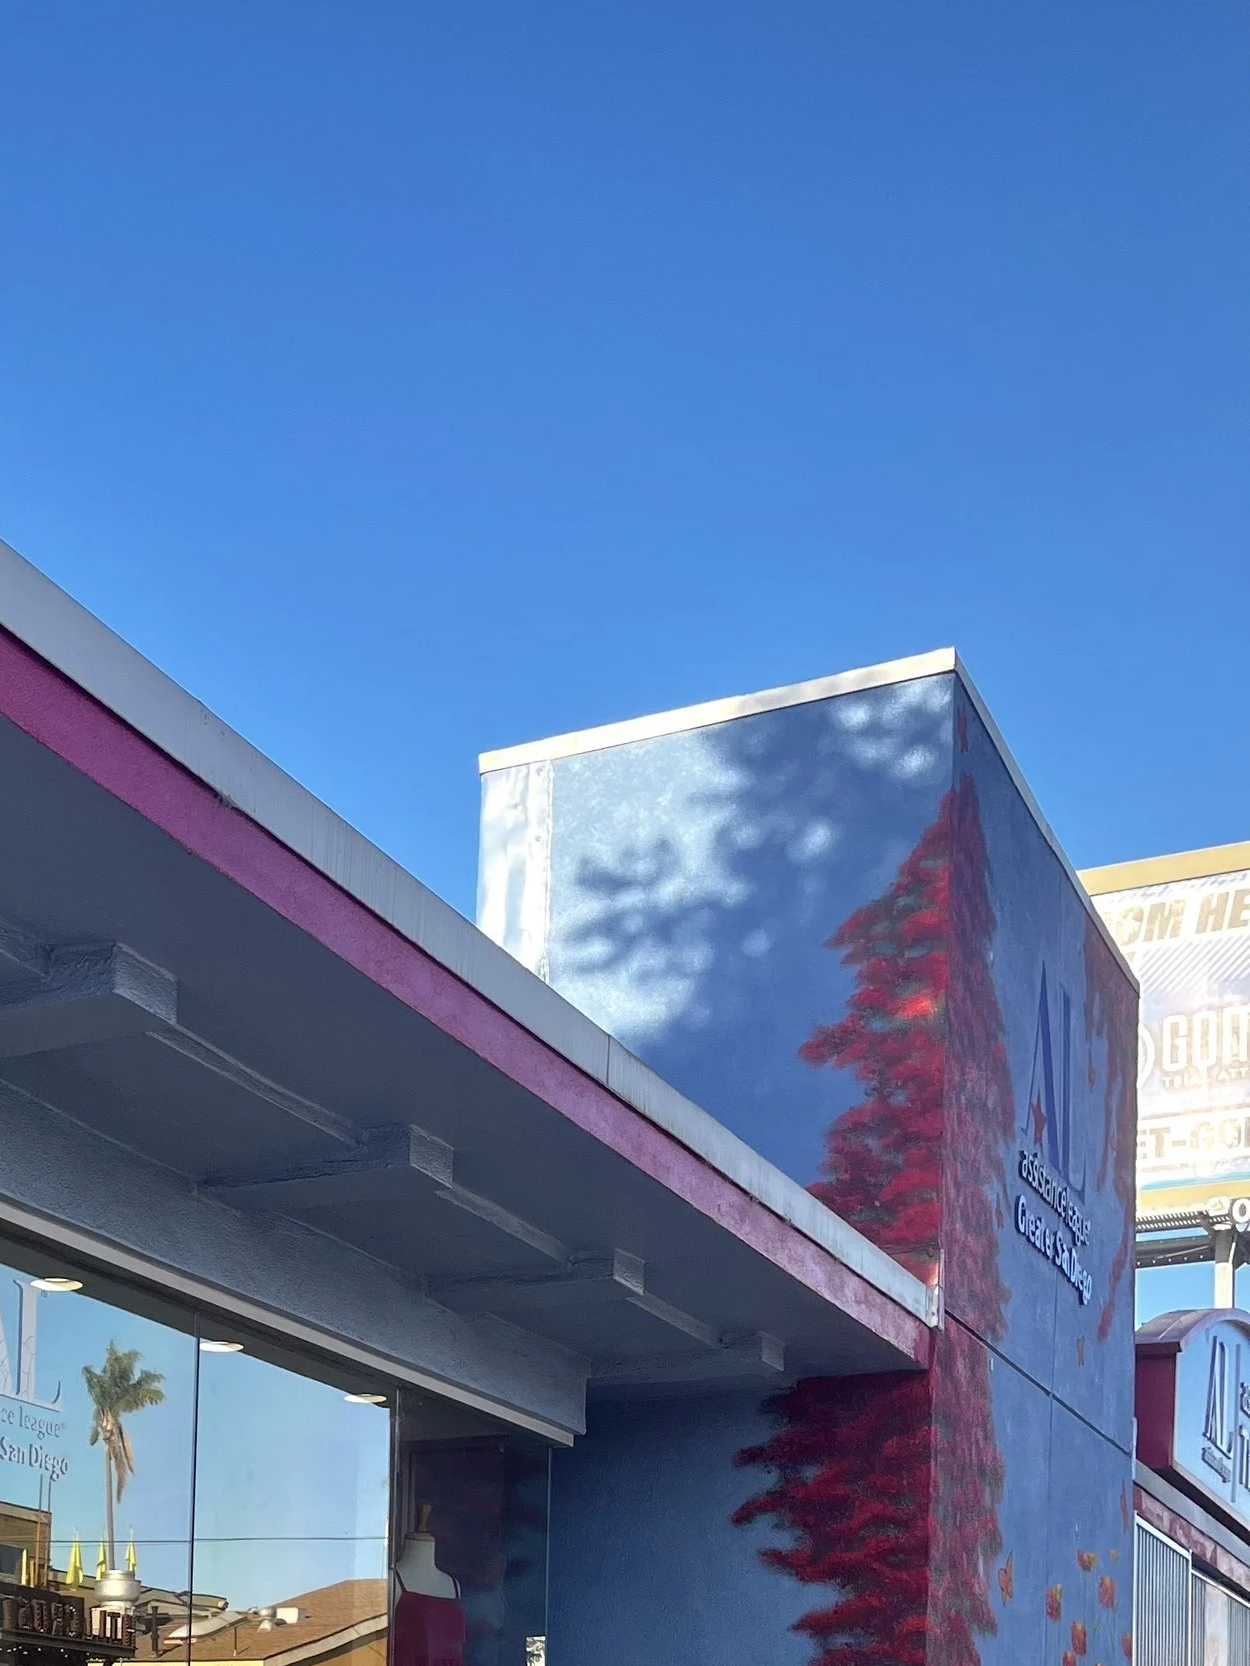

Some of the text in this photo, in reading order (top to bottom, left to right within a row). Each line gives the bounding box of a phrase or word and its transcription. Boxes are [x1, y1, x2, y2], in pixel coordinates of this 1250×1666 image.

[1021, 1150, 1067, 1218] assistance
[1017, 1194, 1093, 1305] Greater San Diego
[0, 1436, 25, 1465] San
[28, 1443, 68, 1481] Diego
